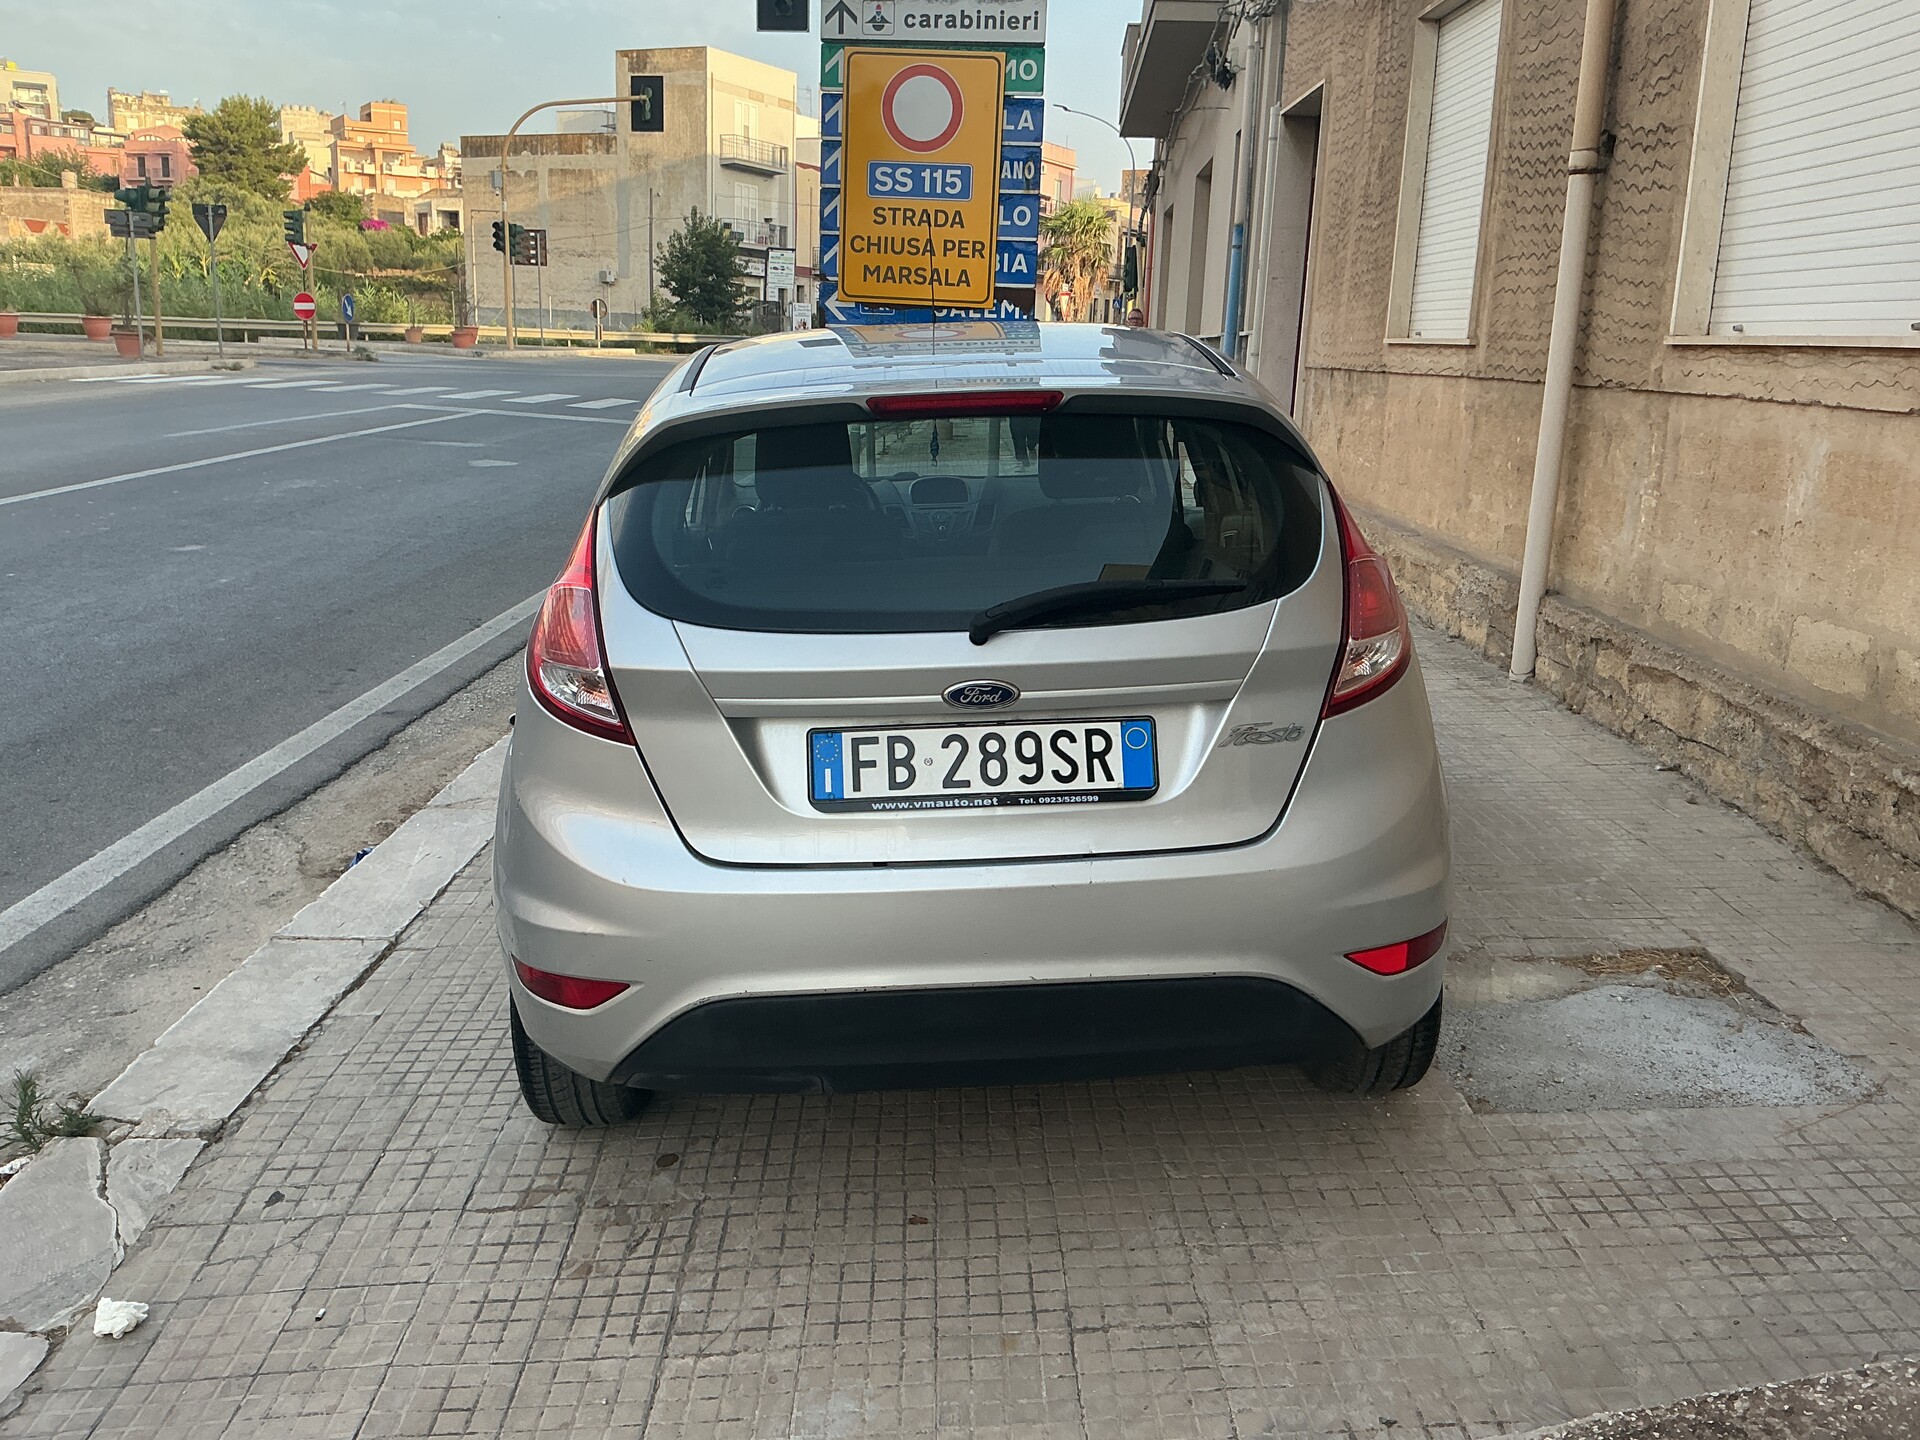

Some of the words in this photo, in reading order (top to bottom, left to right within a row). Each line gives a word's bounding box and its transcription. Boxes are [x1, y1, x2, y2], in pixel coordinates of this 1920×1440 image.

[904, 10, 1039, 30] carabinieri
[874, 166, 913, 193] SS
[921, 167, 962, 195] 115
[872, 206, 965, 229] STRADA
[850, 235, 936, 257] CHIUSA
[943, 239, 985, 259] PER
[995, 252, 1028, 273] IA
[862, 265, 971, 288] MARSALA
[960, 686, 1002, 703] Ford
[850, 735, 916, 793] FB
[940, 727, 1115, 789] 289SR
[871, 797, 999, 810] www.vmauto.net
[1018, 797, 1036, 805] Tel.
[1038, 795, 1100, 805] 0923/526599
